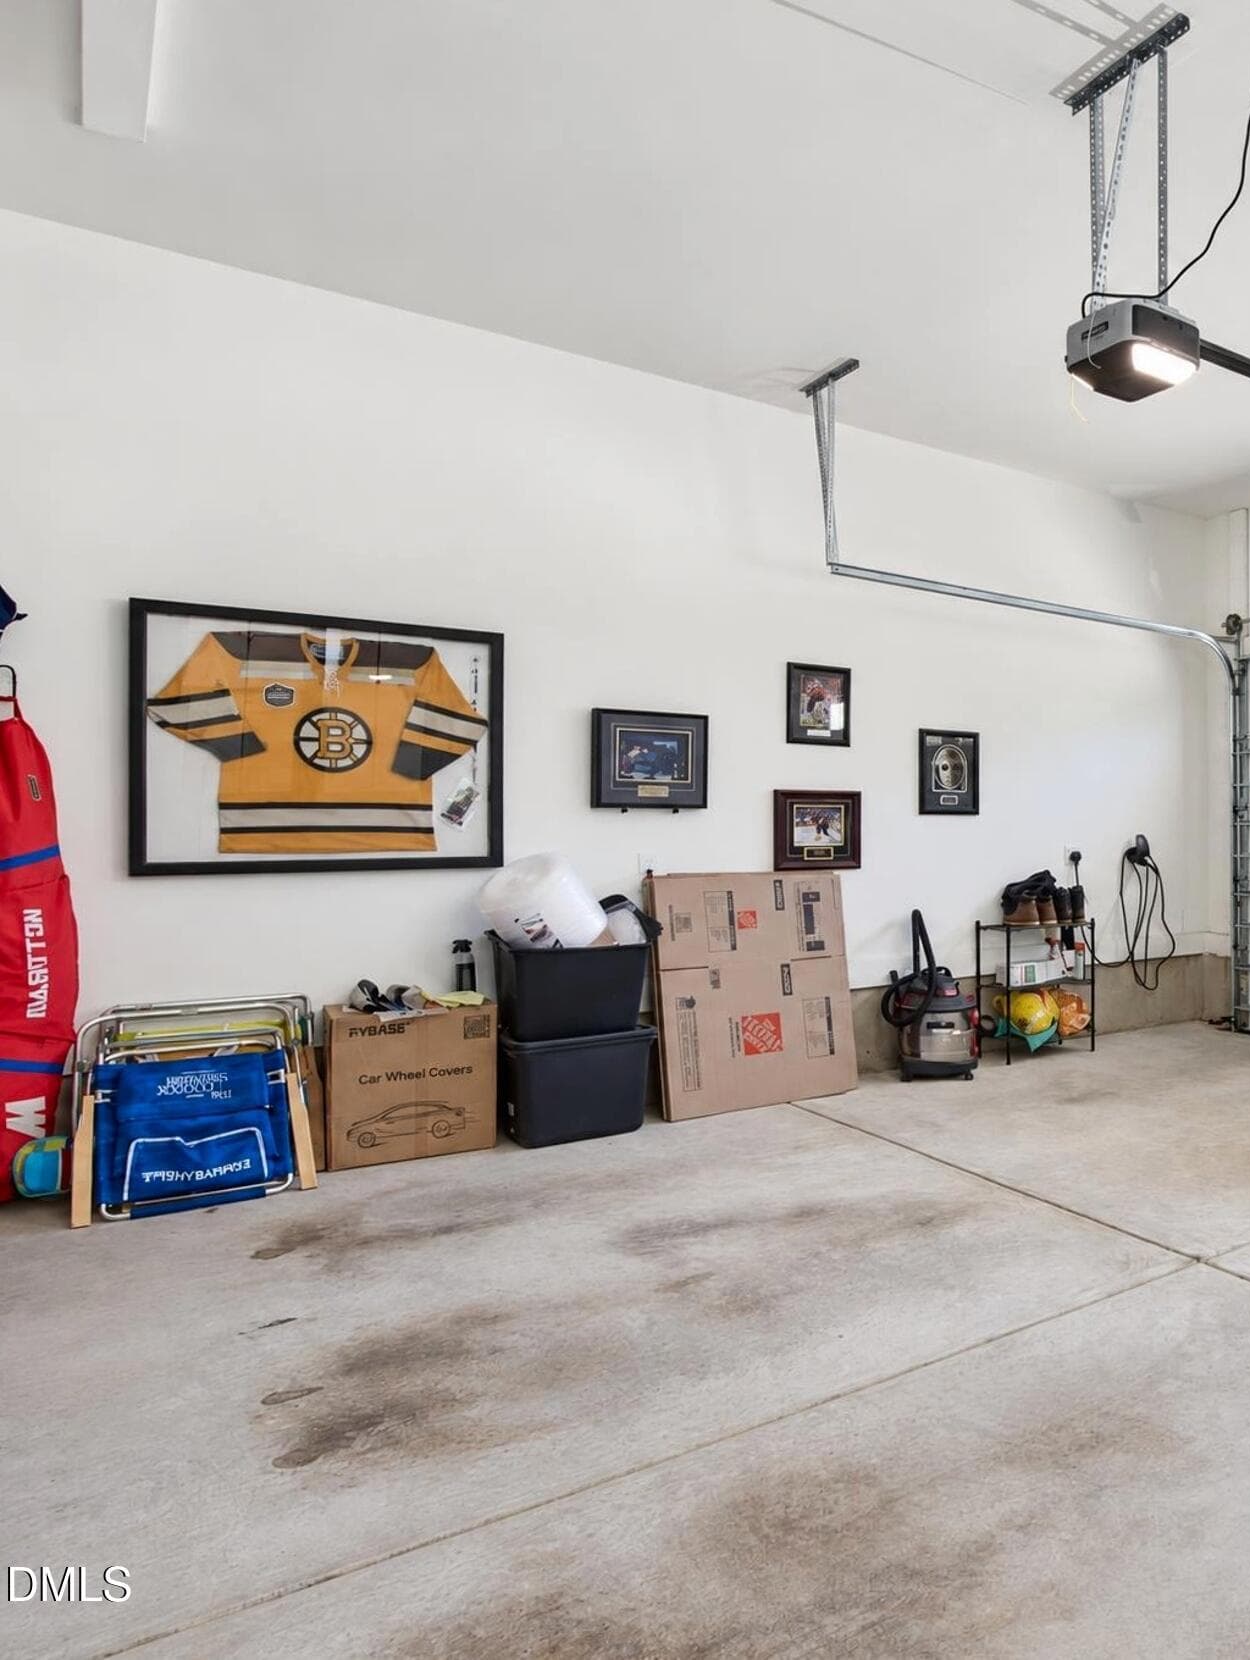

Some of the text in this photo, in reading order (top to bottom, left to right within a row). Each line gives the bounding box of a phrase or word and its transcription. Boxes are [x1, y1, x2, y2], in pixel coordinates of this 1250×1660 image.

[358, 1065, 473, 1085] Car Wheel Covers
